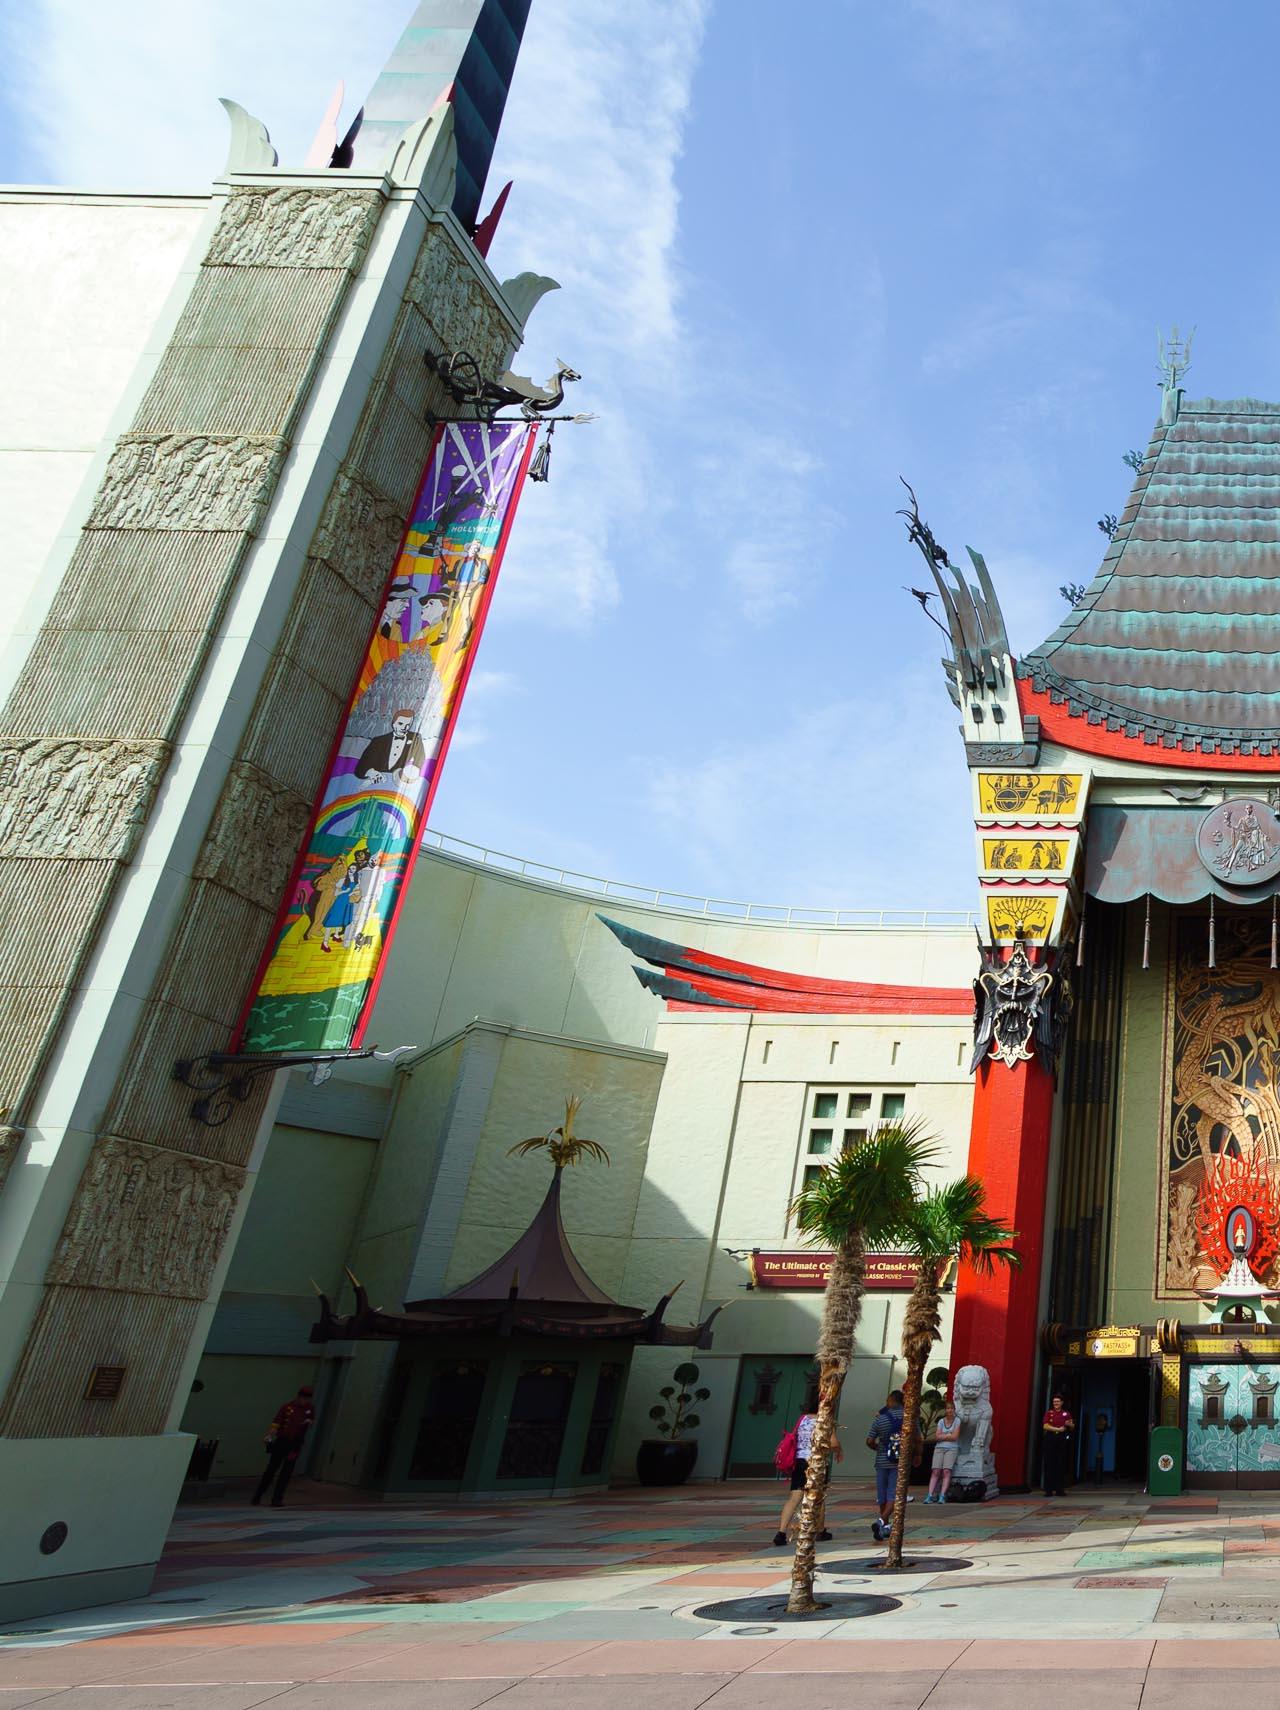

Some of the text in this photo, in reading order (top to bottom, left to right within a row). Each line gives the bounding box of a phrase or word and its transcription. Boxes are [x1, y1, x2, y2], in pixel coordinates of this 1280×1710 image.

[764, 1262, 780, 1270] The
[782, 1262, 818, 1270] Ultimate
[877, 1262, 906, 1271] Classic
